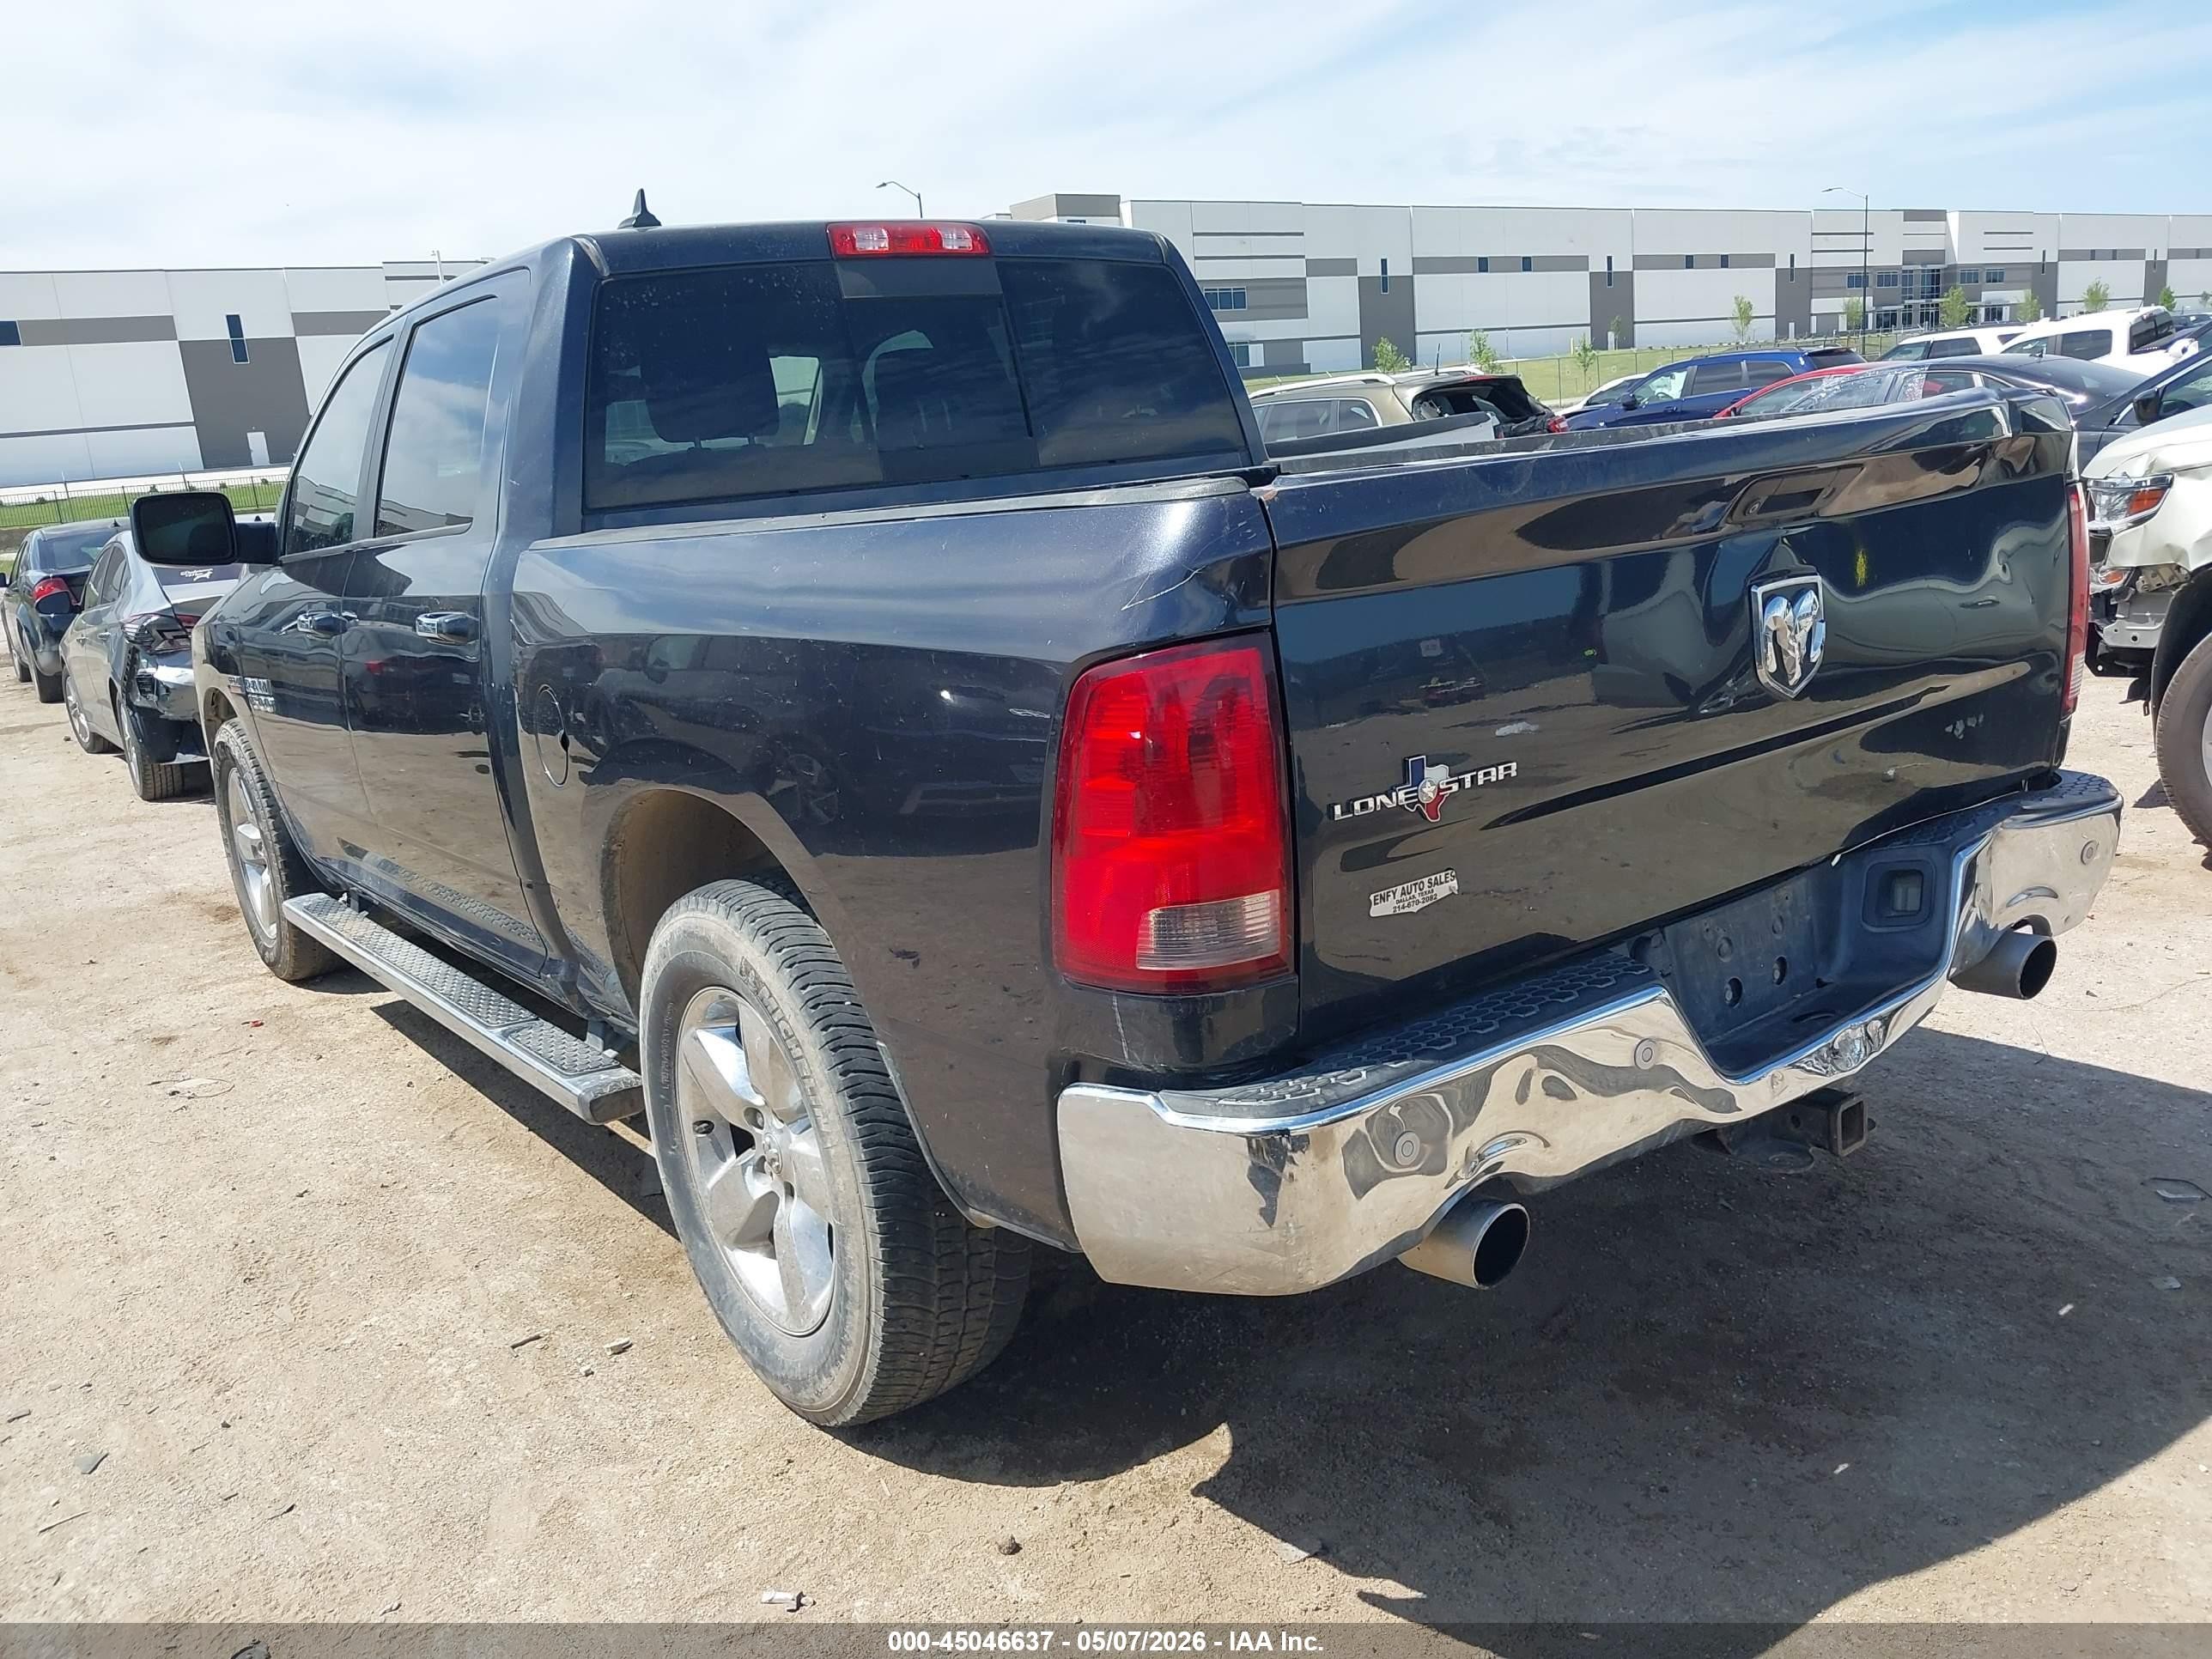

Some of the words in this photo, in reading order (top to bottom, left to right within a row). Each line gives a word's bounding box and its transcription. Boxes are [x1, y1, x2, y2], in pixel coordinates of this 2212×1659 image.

[1333, 787, 1419, 821] LONE
[1438, 762, 1518, 795] STAR
[1373, 889, 1398, 906] ENFY
[1401, 880, 1425, 897] AUTO
[1427, 871, 1455, 889] SALES
[1418, 888, 1434, 897] TEXAS
[759, 984, 831, 1131] MICHELIN
